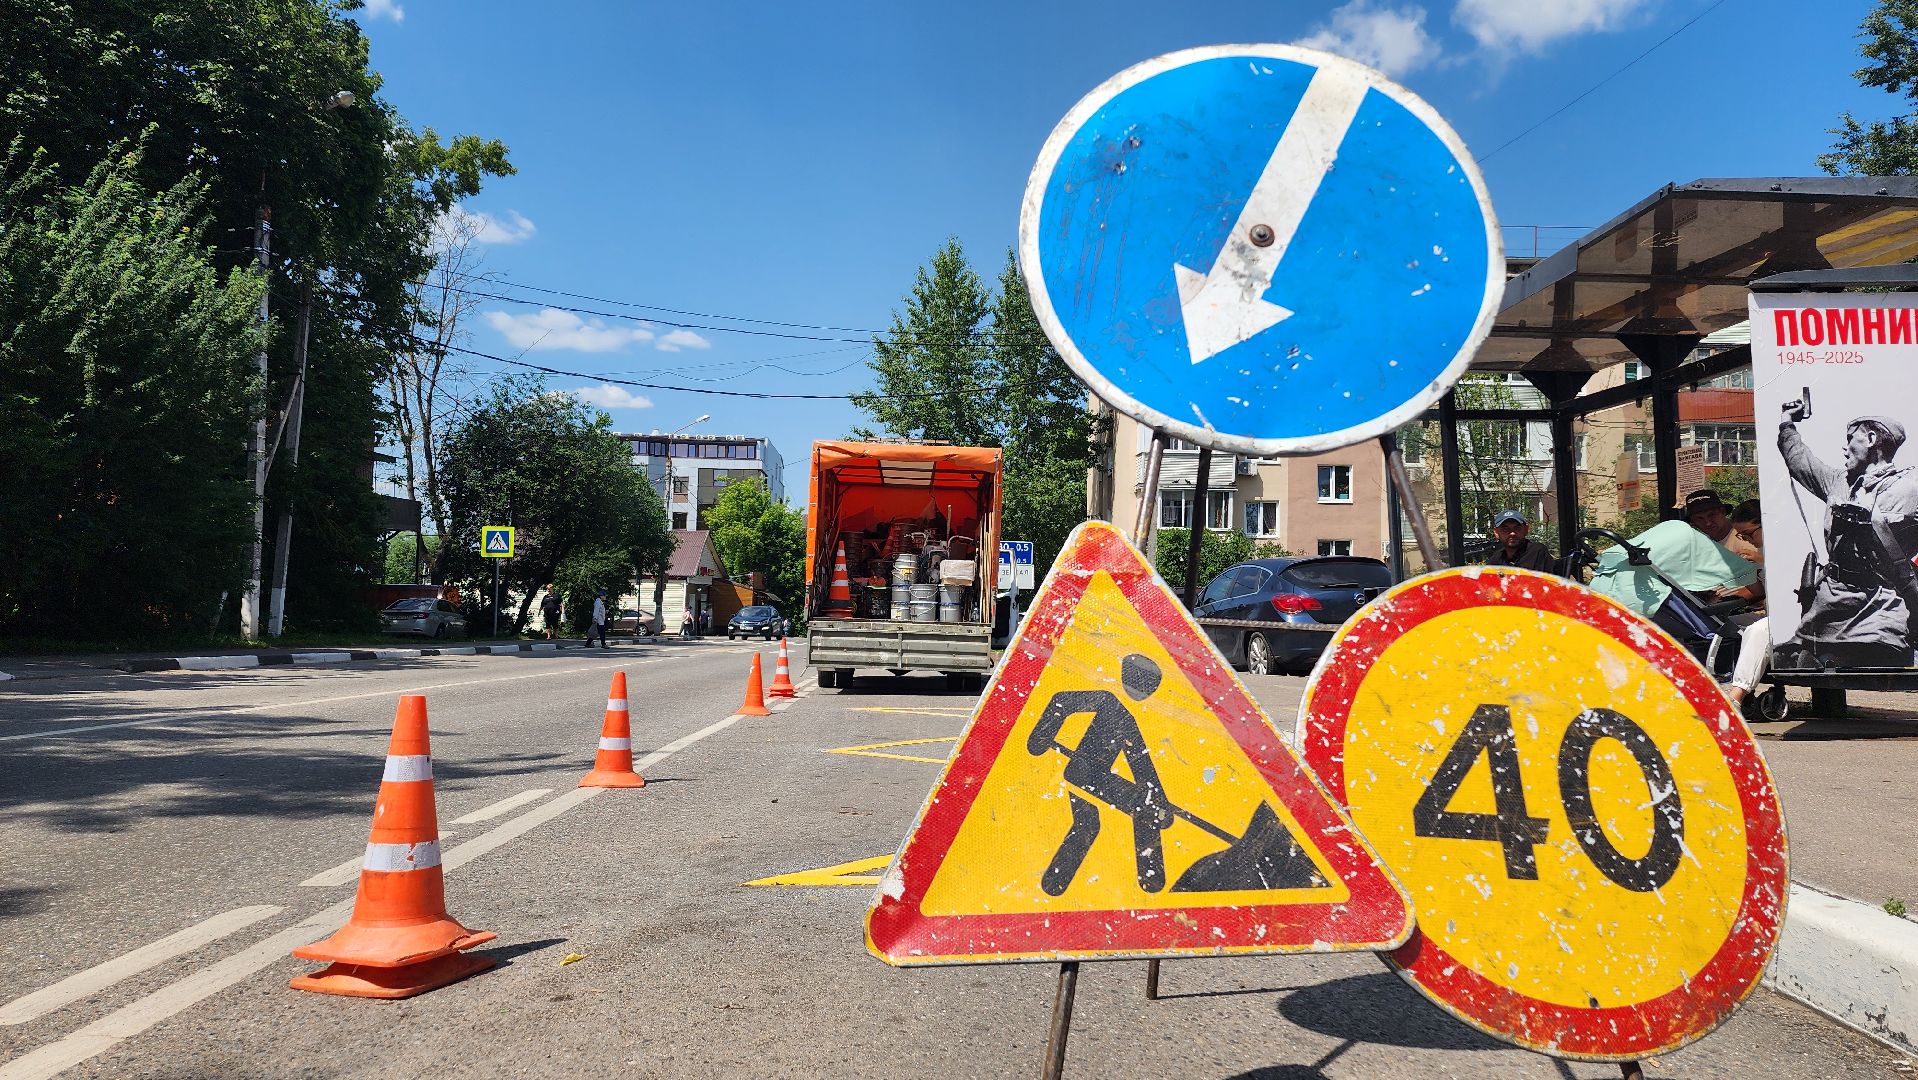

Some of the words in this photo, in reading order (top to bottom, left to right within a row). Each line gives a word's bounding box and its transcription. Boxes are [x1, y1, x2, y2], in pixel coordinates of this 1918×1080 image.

[1774, 307, 1918, 346] ПОМНИ
[1016, 543, 1029, 551] 0.5
[1413, 704, 1687, 893] 40
